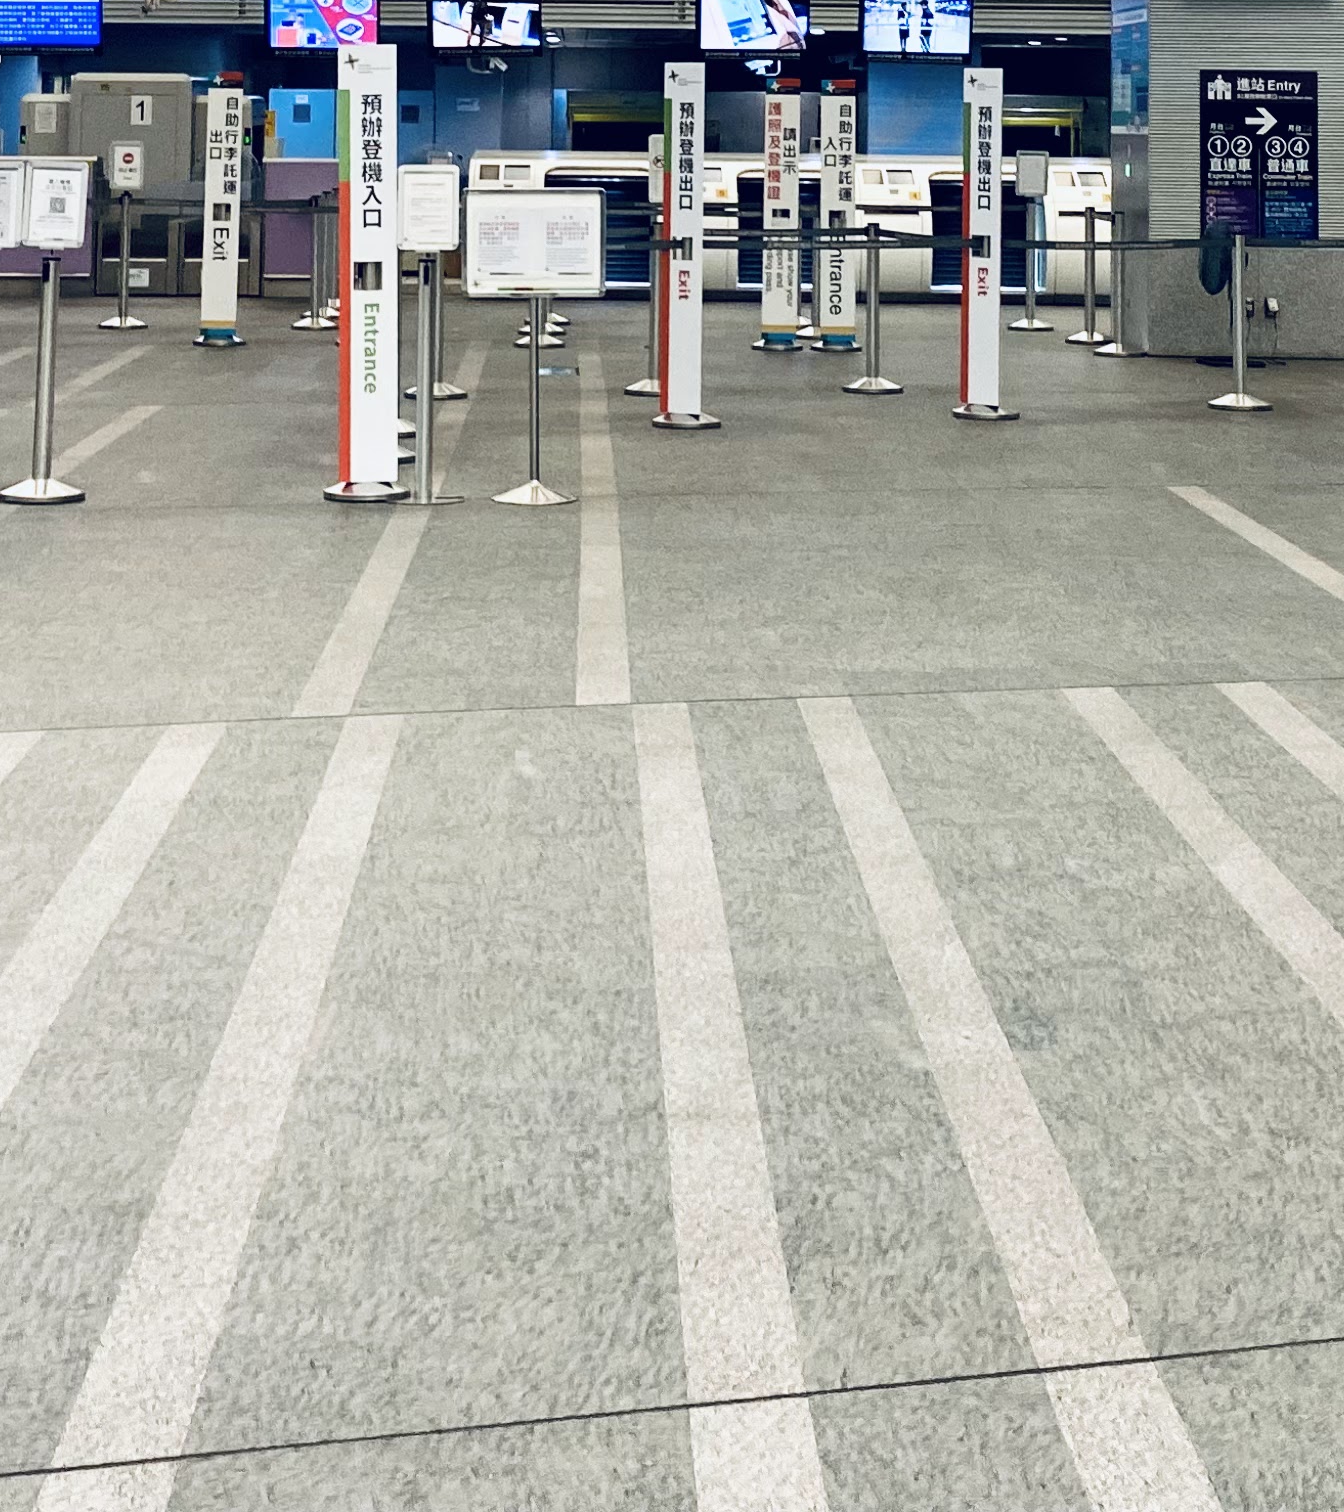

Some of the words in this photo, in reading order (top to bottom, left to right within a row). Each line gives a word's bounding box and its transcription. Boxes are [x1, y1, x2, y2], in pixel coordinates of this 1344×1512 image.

[1237, 76, 1265, 91] 進站
[1268, 79, 1301, 94] Entry
[136, 99, 145, 122] 1
[209, 129, 223, 160] 出口
[223, 96, 239, 195] 自助行李託運
[360, 93, 383, 228] 預辦登機入口
[678, 102, 695, 210] 預辦登機出口
[823, 136, 837, 168] 入口
[838, 104, 853, 202] 自助行李託運
[977, 106, 993, 210] 預辦登機出口
[213, 227, 230, 261] Exit
[678, 270, 690, 300] Exit
[978, 267, 989, 297] Exit
[364, 302, 380, 394] Entrance
